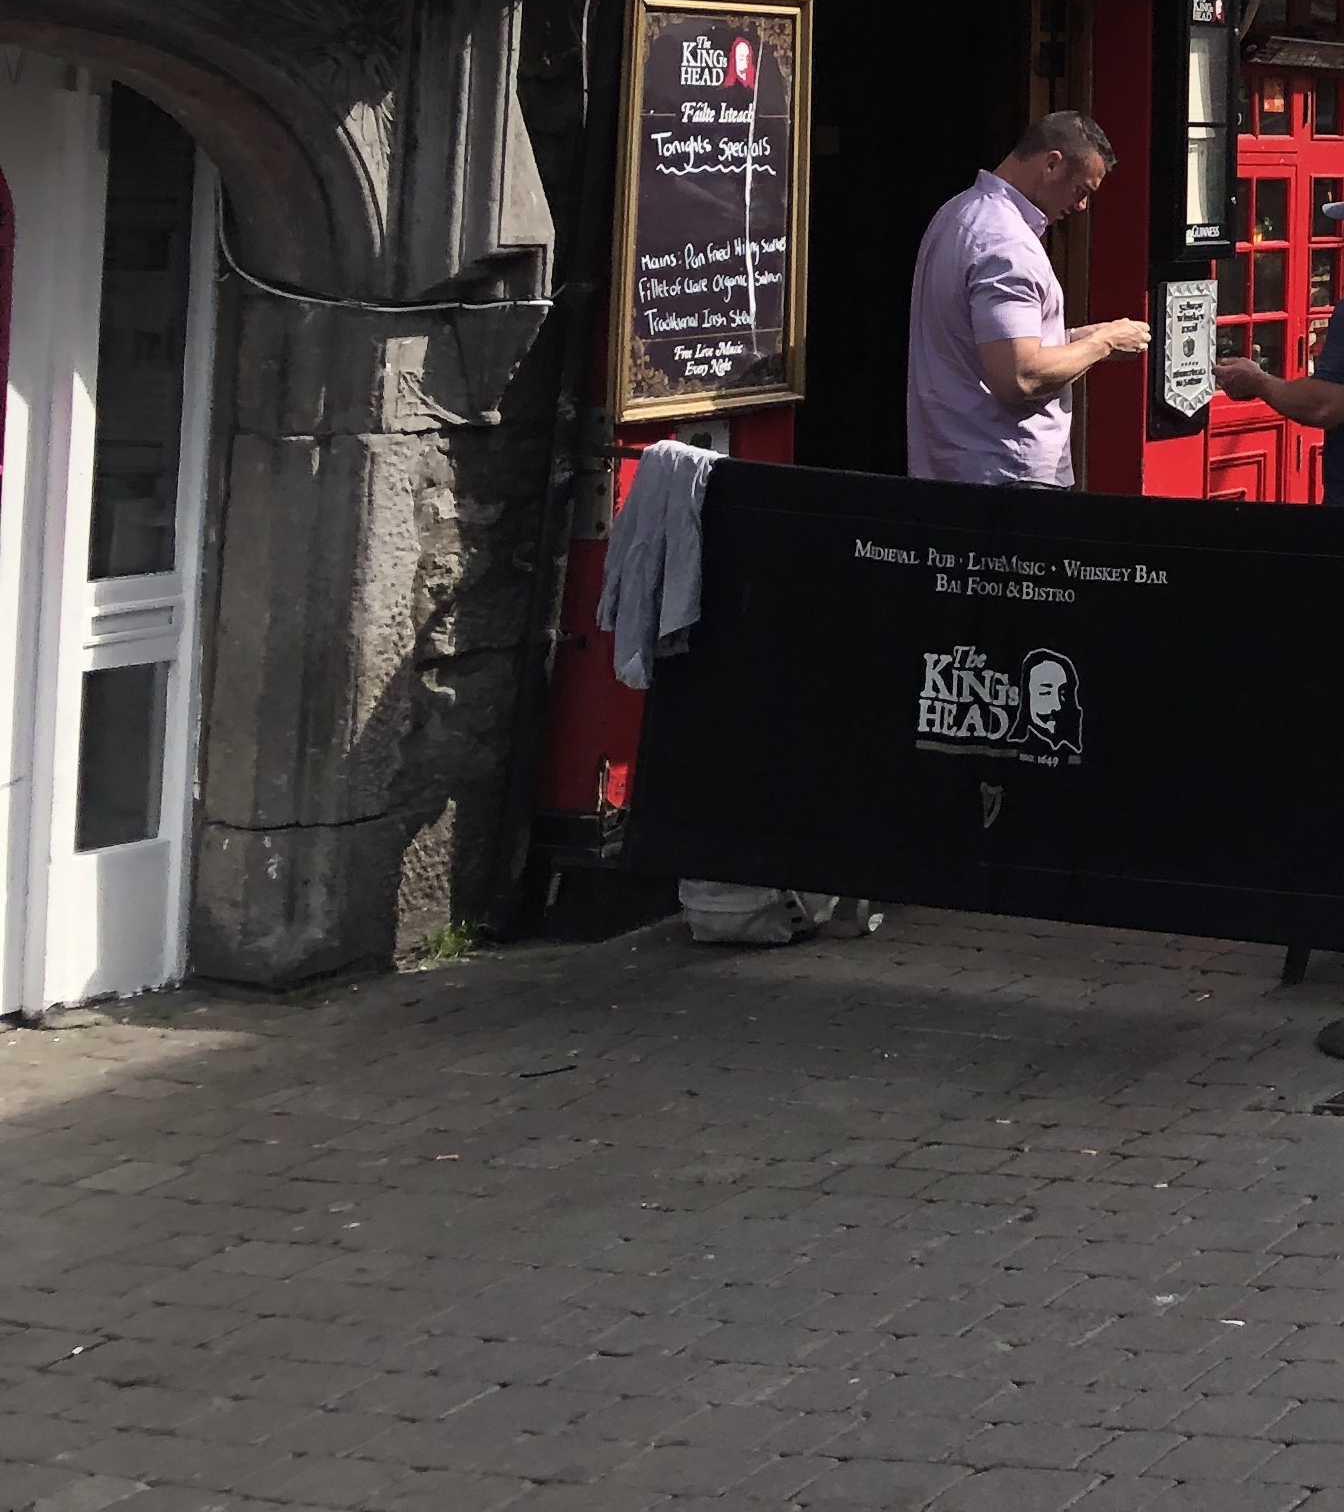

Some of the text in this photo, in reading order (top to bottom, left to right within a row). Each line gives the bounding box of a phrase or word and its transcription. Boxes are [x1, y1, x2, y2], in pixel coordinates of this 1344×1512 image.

[696, 36, 712, 50] The
[680, 67, 724, 86] HEAD
[684, 242, 706, 270] Pan
[706, 240, 731, 264] Fried
[669, 276, 682, 298] of
[712, 274, 748, 304] Organic
[702, 308, 727, 329] Irish
[674, 340, 744, 361] Free Live Music
[854, 539, 920, 565] MEDIEVAL
[927, 546, 955, 568] PUB
[1063, 559, 1132, 583] WHISKEY
[1134, 564, 1169, 585] BAR
[1006, 581, 1020, 598] &
[1021, 581, 1076, 603] BISTRO
[953, 645, 988, 669] The
[917, 698, 1009, 740] HEAD
